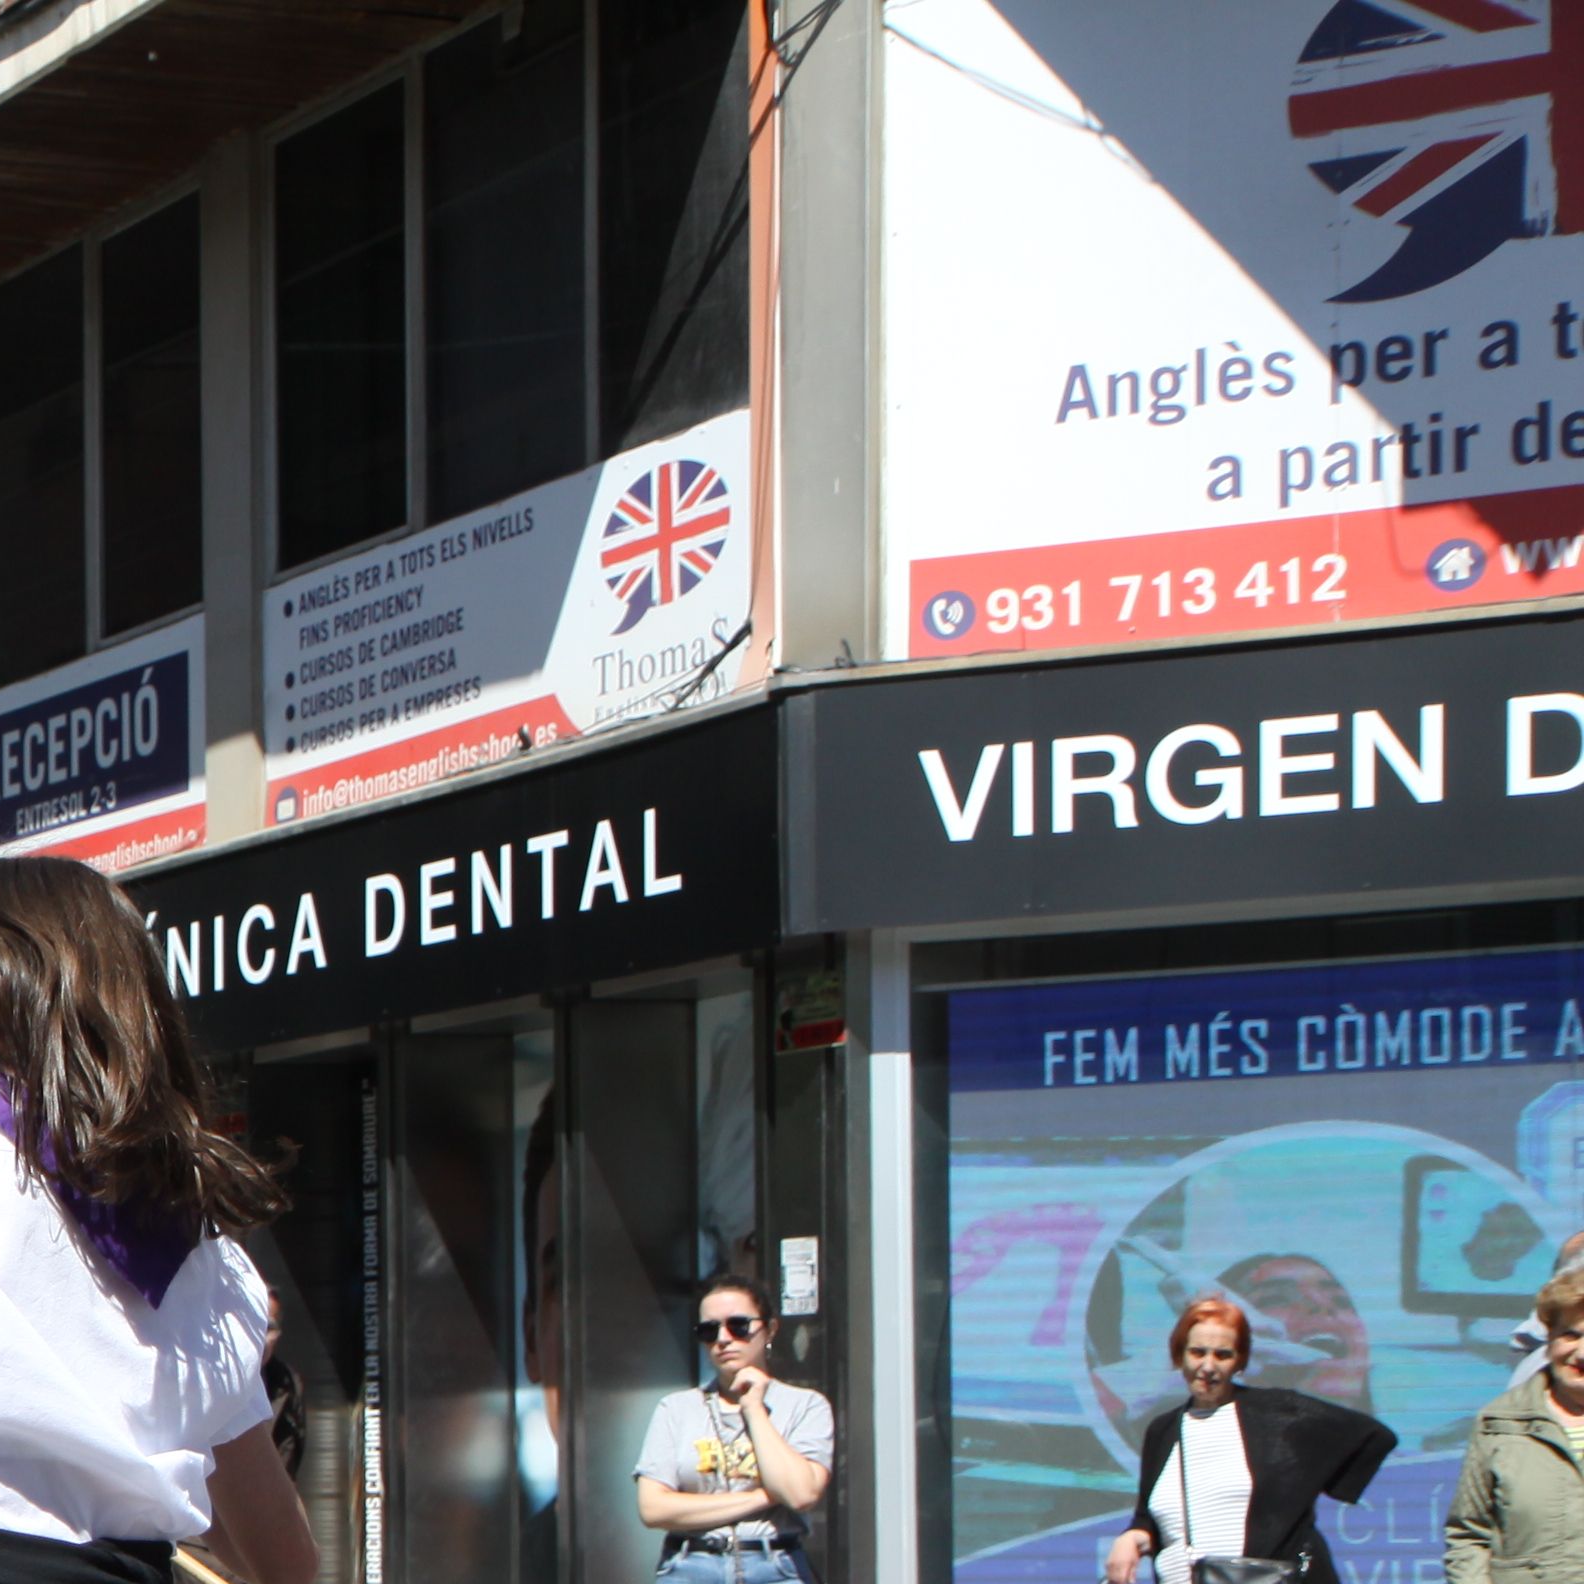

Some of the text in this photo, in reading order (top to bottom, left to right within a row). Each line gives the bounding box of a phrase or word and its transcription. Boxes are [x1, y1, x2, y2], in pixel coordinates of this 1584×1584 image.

[1054, 300, 1584, 427] Anglès per a t
[1205, 452, 1243, 503] a
[1278, 411, 1481, 510] partir
[298, 507, 535, 615] ANGLÈS PER A TOTS ELS NIVELLS
[985, 579, 1083, 637] 931
[1107, 567, 1218, 623] 713
[1233, 552, 1349, 608] 412
[298, 584, 425, 651] FINS PROFICIENCY
[299, 607, 466, 686] CURSOS DE CAMBRIDGE
[299, 647, 458, 719] CURSOS DE CONVERSA
[300, 676, 482, 754] CURSOS PER A EMPRESES
[15, 780, 117, 836] ENTRESOL 2-3
[917, 703, 1446, 843] VIRGEN
[145, 808, 682, 998] NICA DENTAL
[1042, 1026, 1140, 1087] FEM
[1163, 1011, 1270, 1081] MÉS
[1296, 1003, 1529, 1074] CÒMODE
[363, 1189, 378, 1211] DE
[363, 1216, 379, 1277] FORMA
[363, 1281, 379, 1351] NOSTRA
[364, 1355, 379, 1377] LA
[364, 1381, 380, 1403] EN
[364, 1407, 383, 1496] CONFIANT
